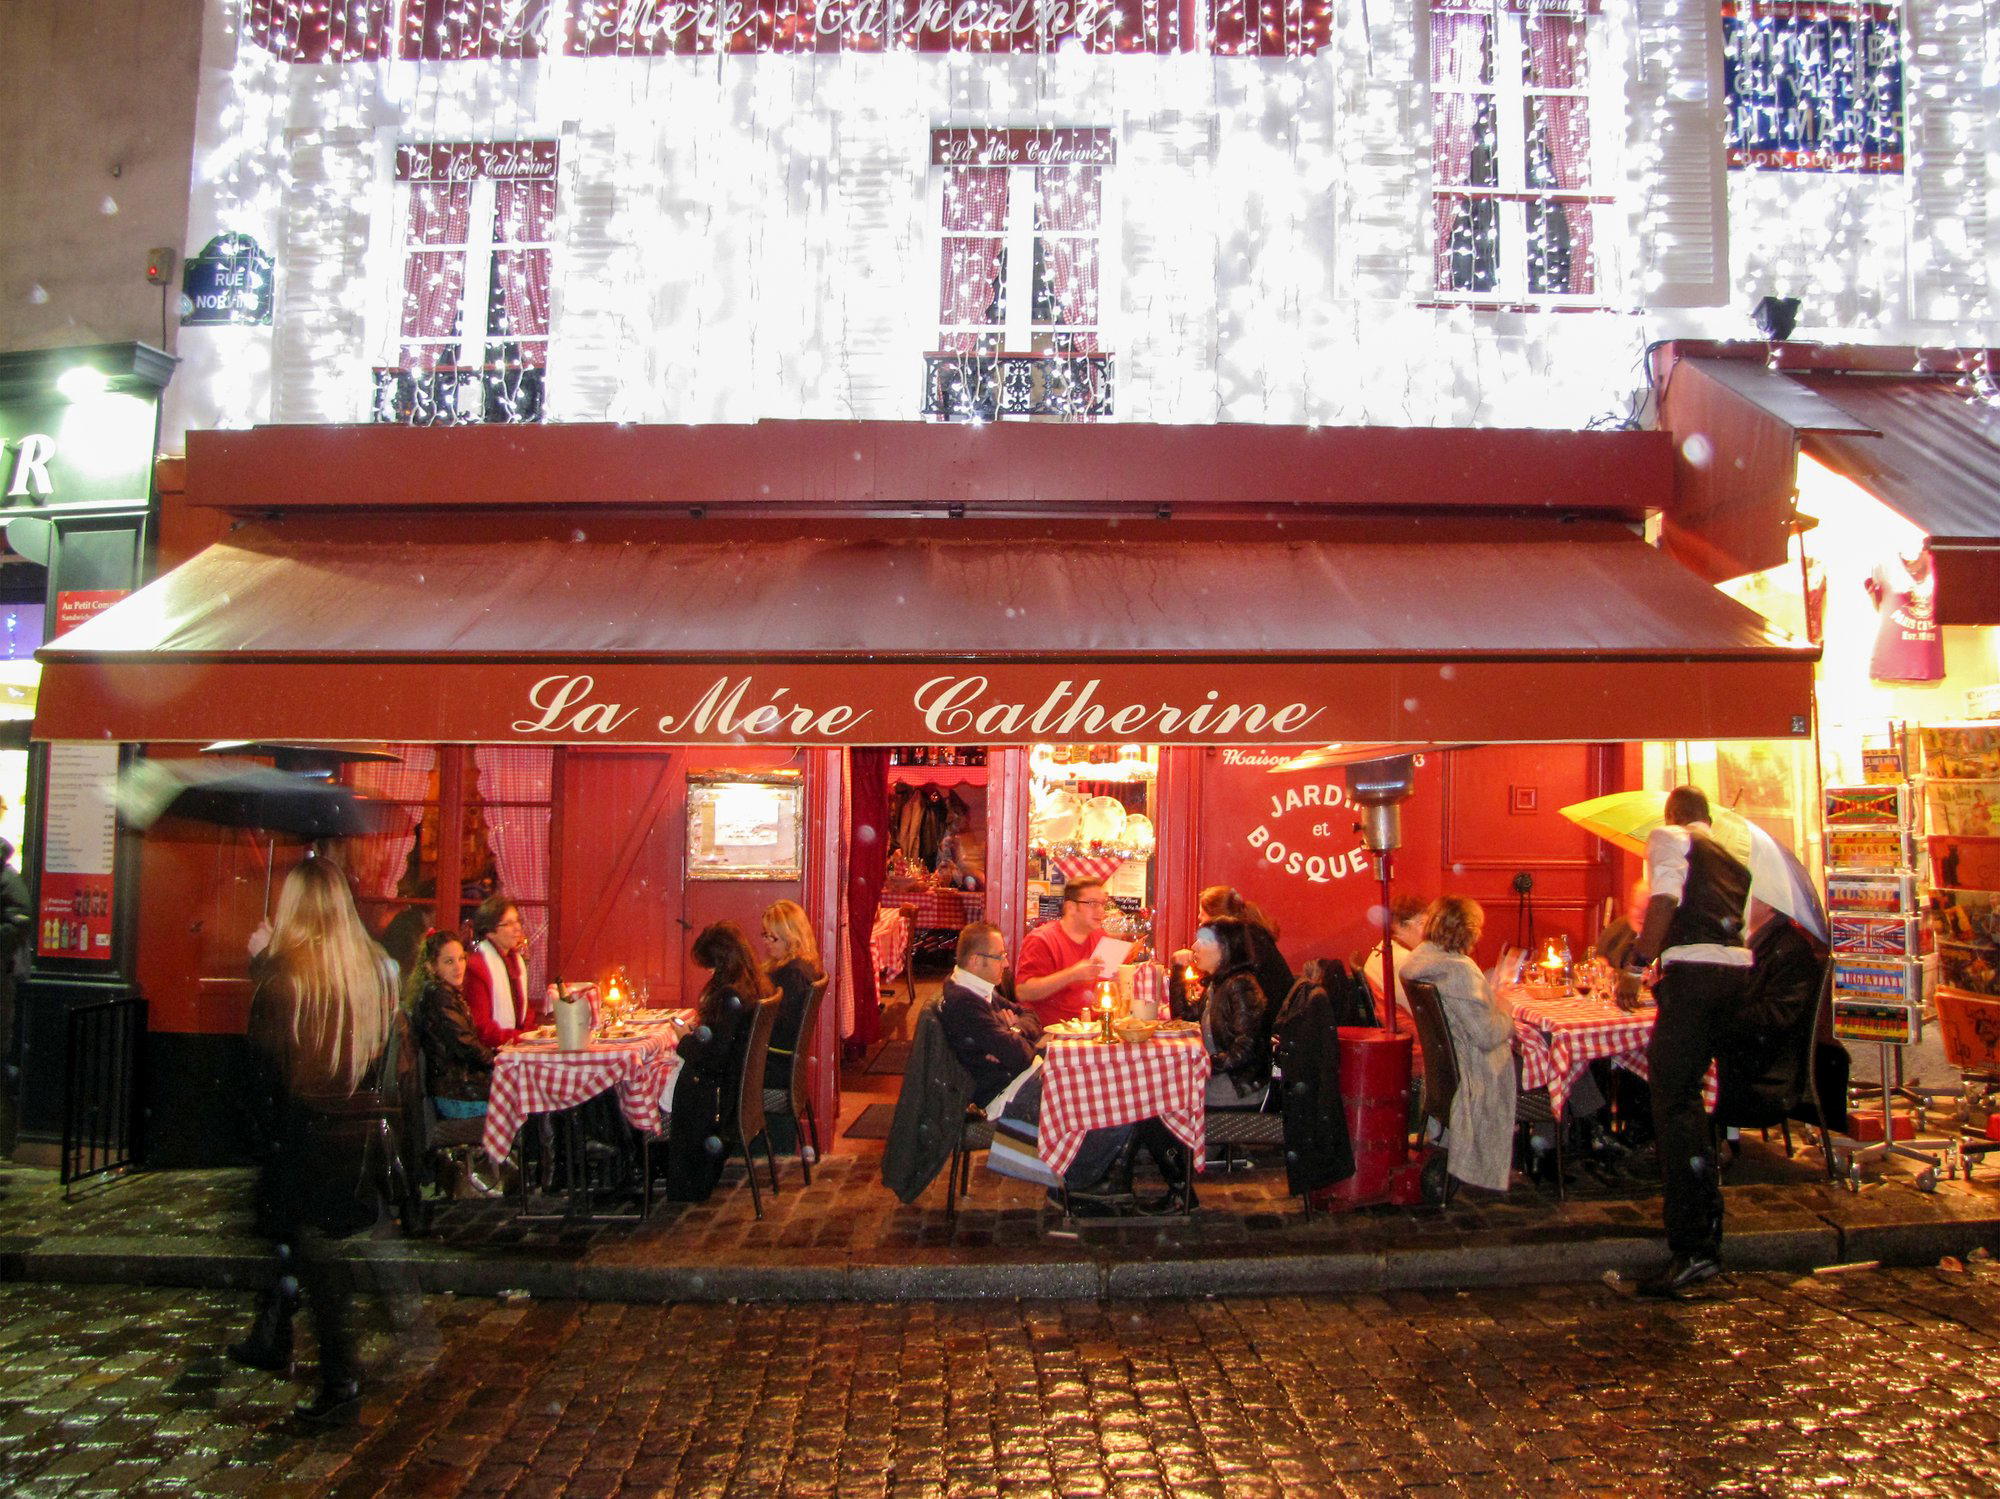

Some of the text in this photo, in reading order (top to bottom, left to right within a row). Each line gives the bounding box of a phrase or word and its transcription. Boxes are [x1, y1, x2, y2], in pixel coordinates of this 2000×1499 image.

[815, 0, 1112, 36] Caherine
[215, 273, 244, 287] RUE
[0, 433, 56, 496] R
[62, 602, 73, 610] Au
[74, 600, 91, 610] Petit
[511, 674, 1328, 736] La Mére Catherine
[1222, 748, 1291, 766] Maison
[1312, 822, 1331, 836] et
[1246, 825, 1369, 883] BOSQUE
